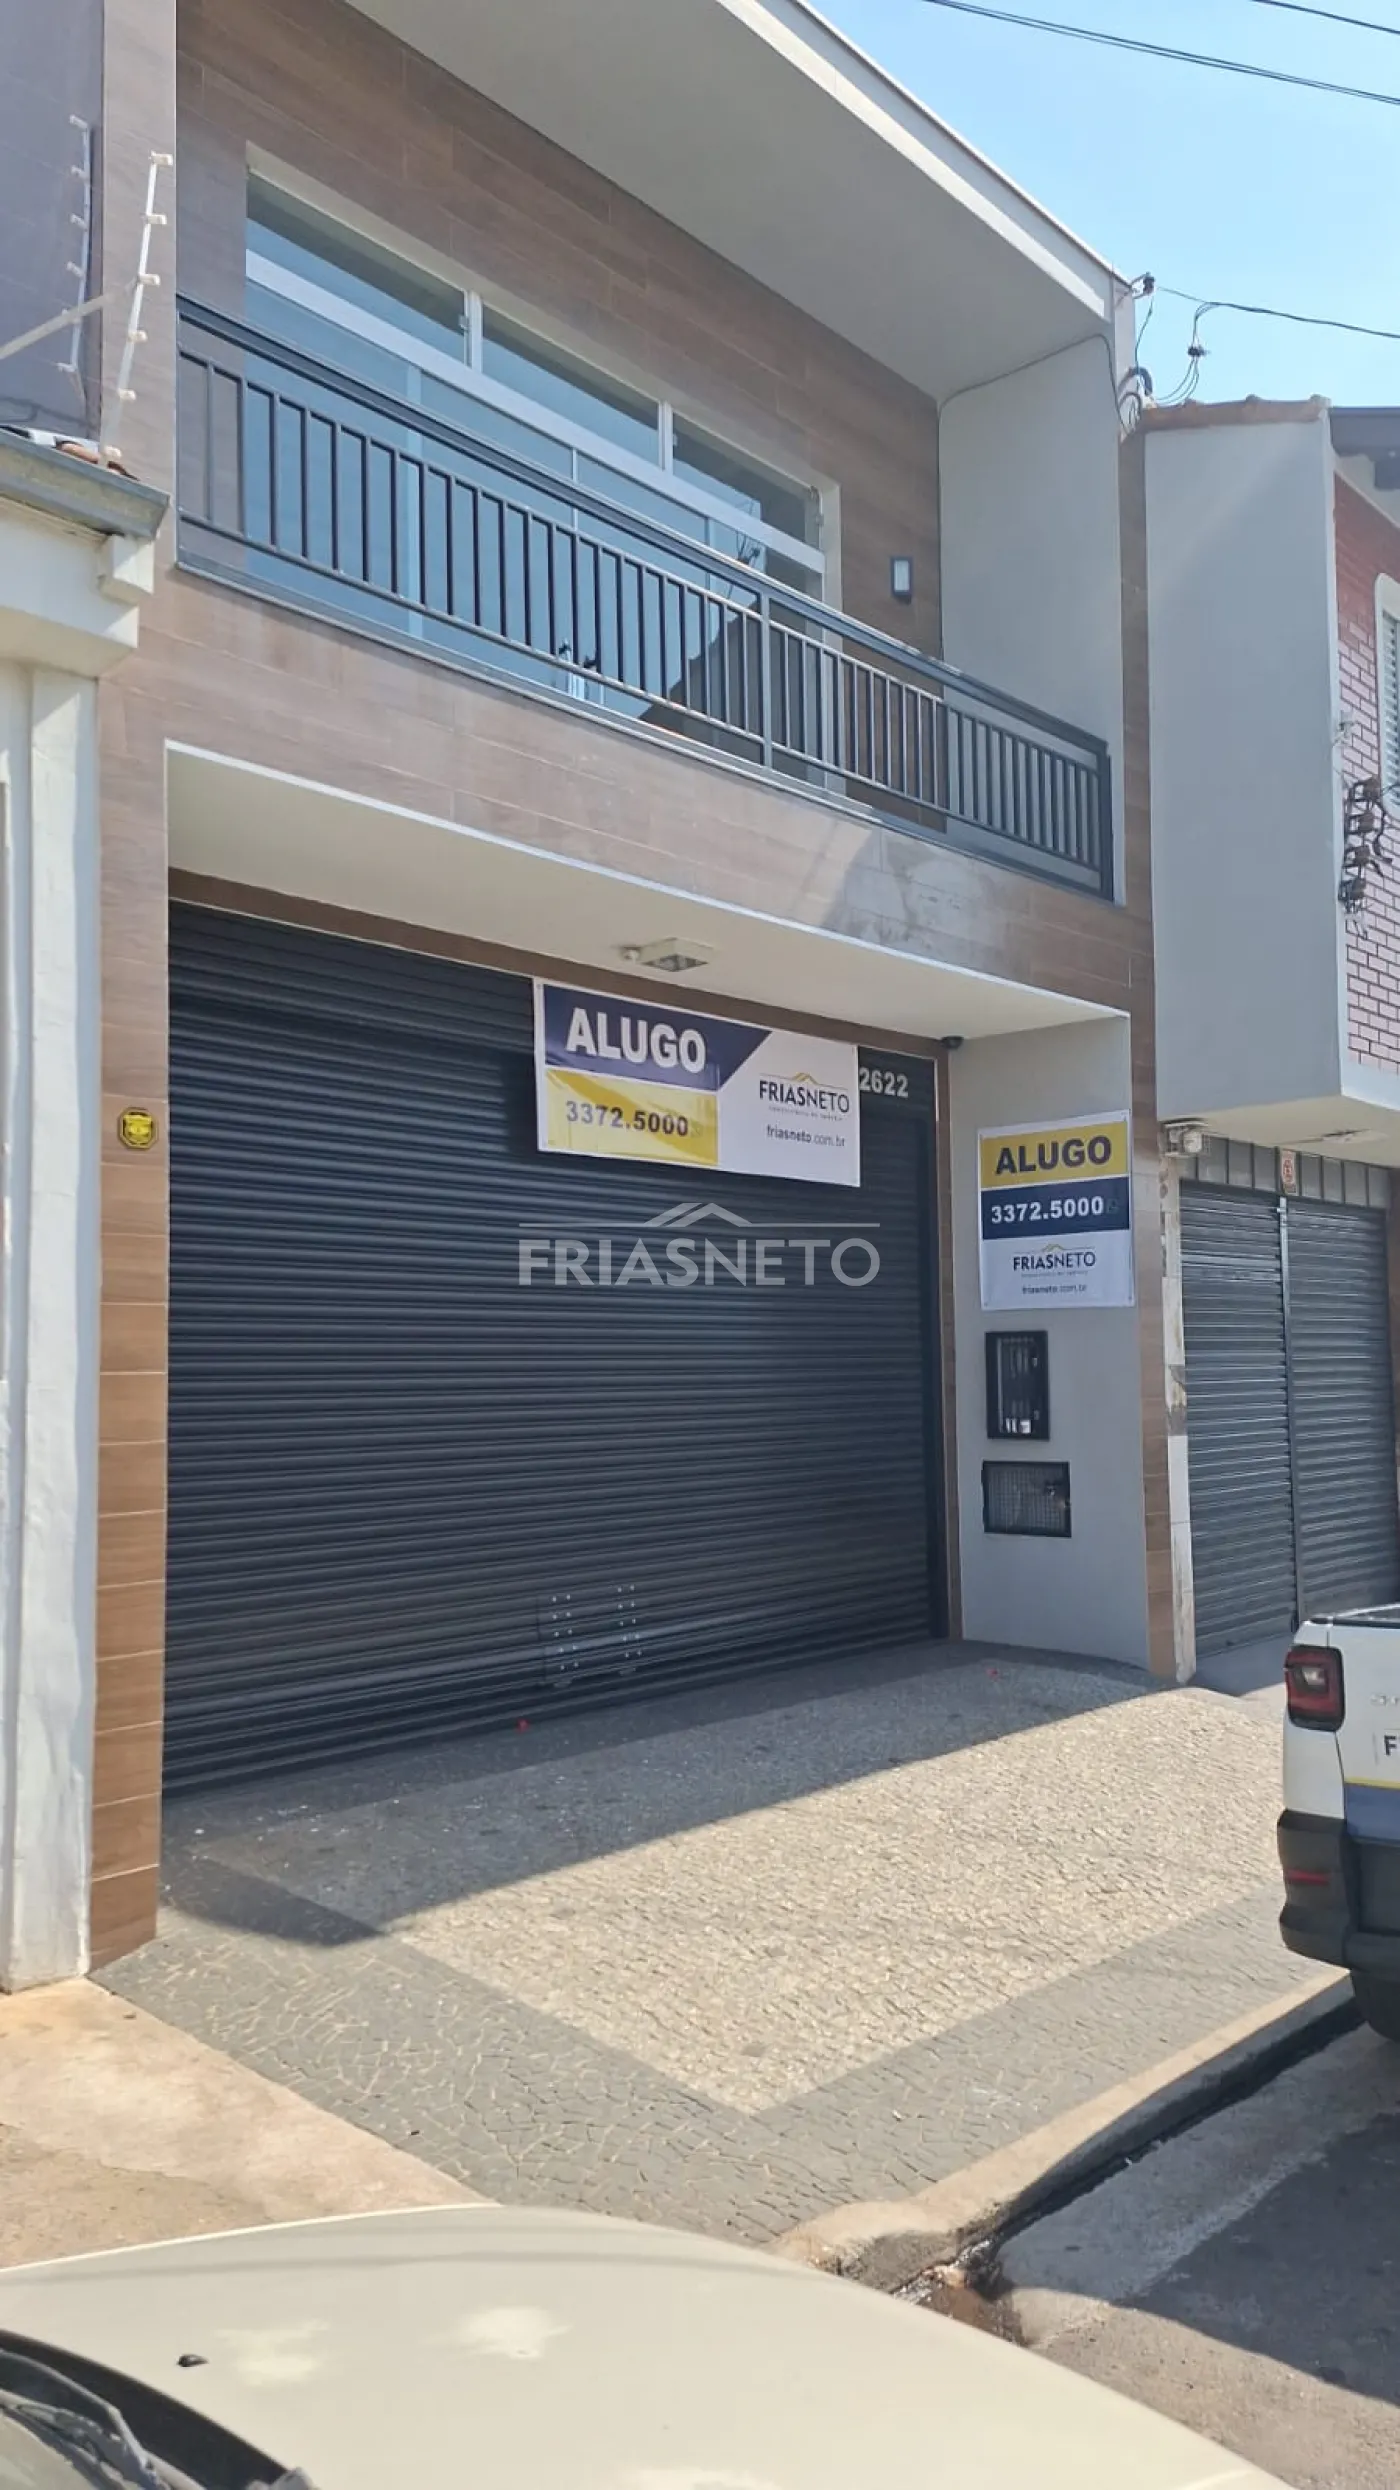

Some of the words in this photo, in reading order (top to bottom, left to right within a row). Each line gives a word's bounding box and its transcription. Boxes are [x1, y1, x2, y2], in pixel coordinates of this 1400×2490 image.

[566, 1008, 706, 1074] ALUGO
[759, 1080, 850, 1113] FRIASNETO
[859, 1067, 909, 1098] 2622
[566, 1101, 689, 1136] 3372.5000
[766, 1123, 845, 1147] friasneto.com.br
[995, 1135, 1112, 1174] ALUGO
[991, 1196, 1103, 1224] 3372.5000
[1013, 1251, 1096, 1271] FRIASNETO
[1384, 1734, 1400, 1756] F
